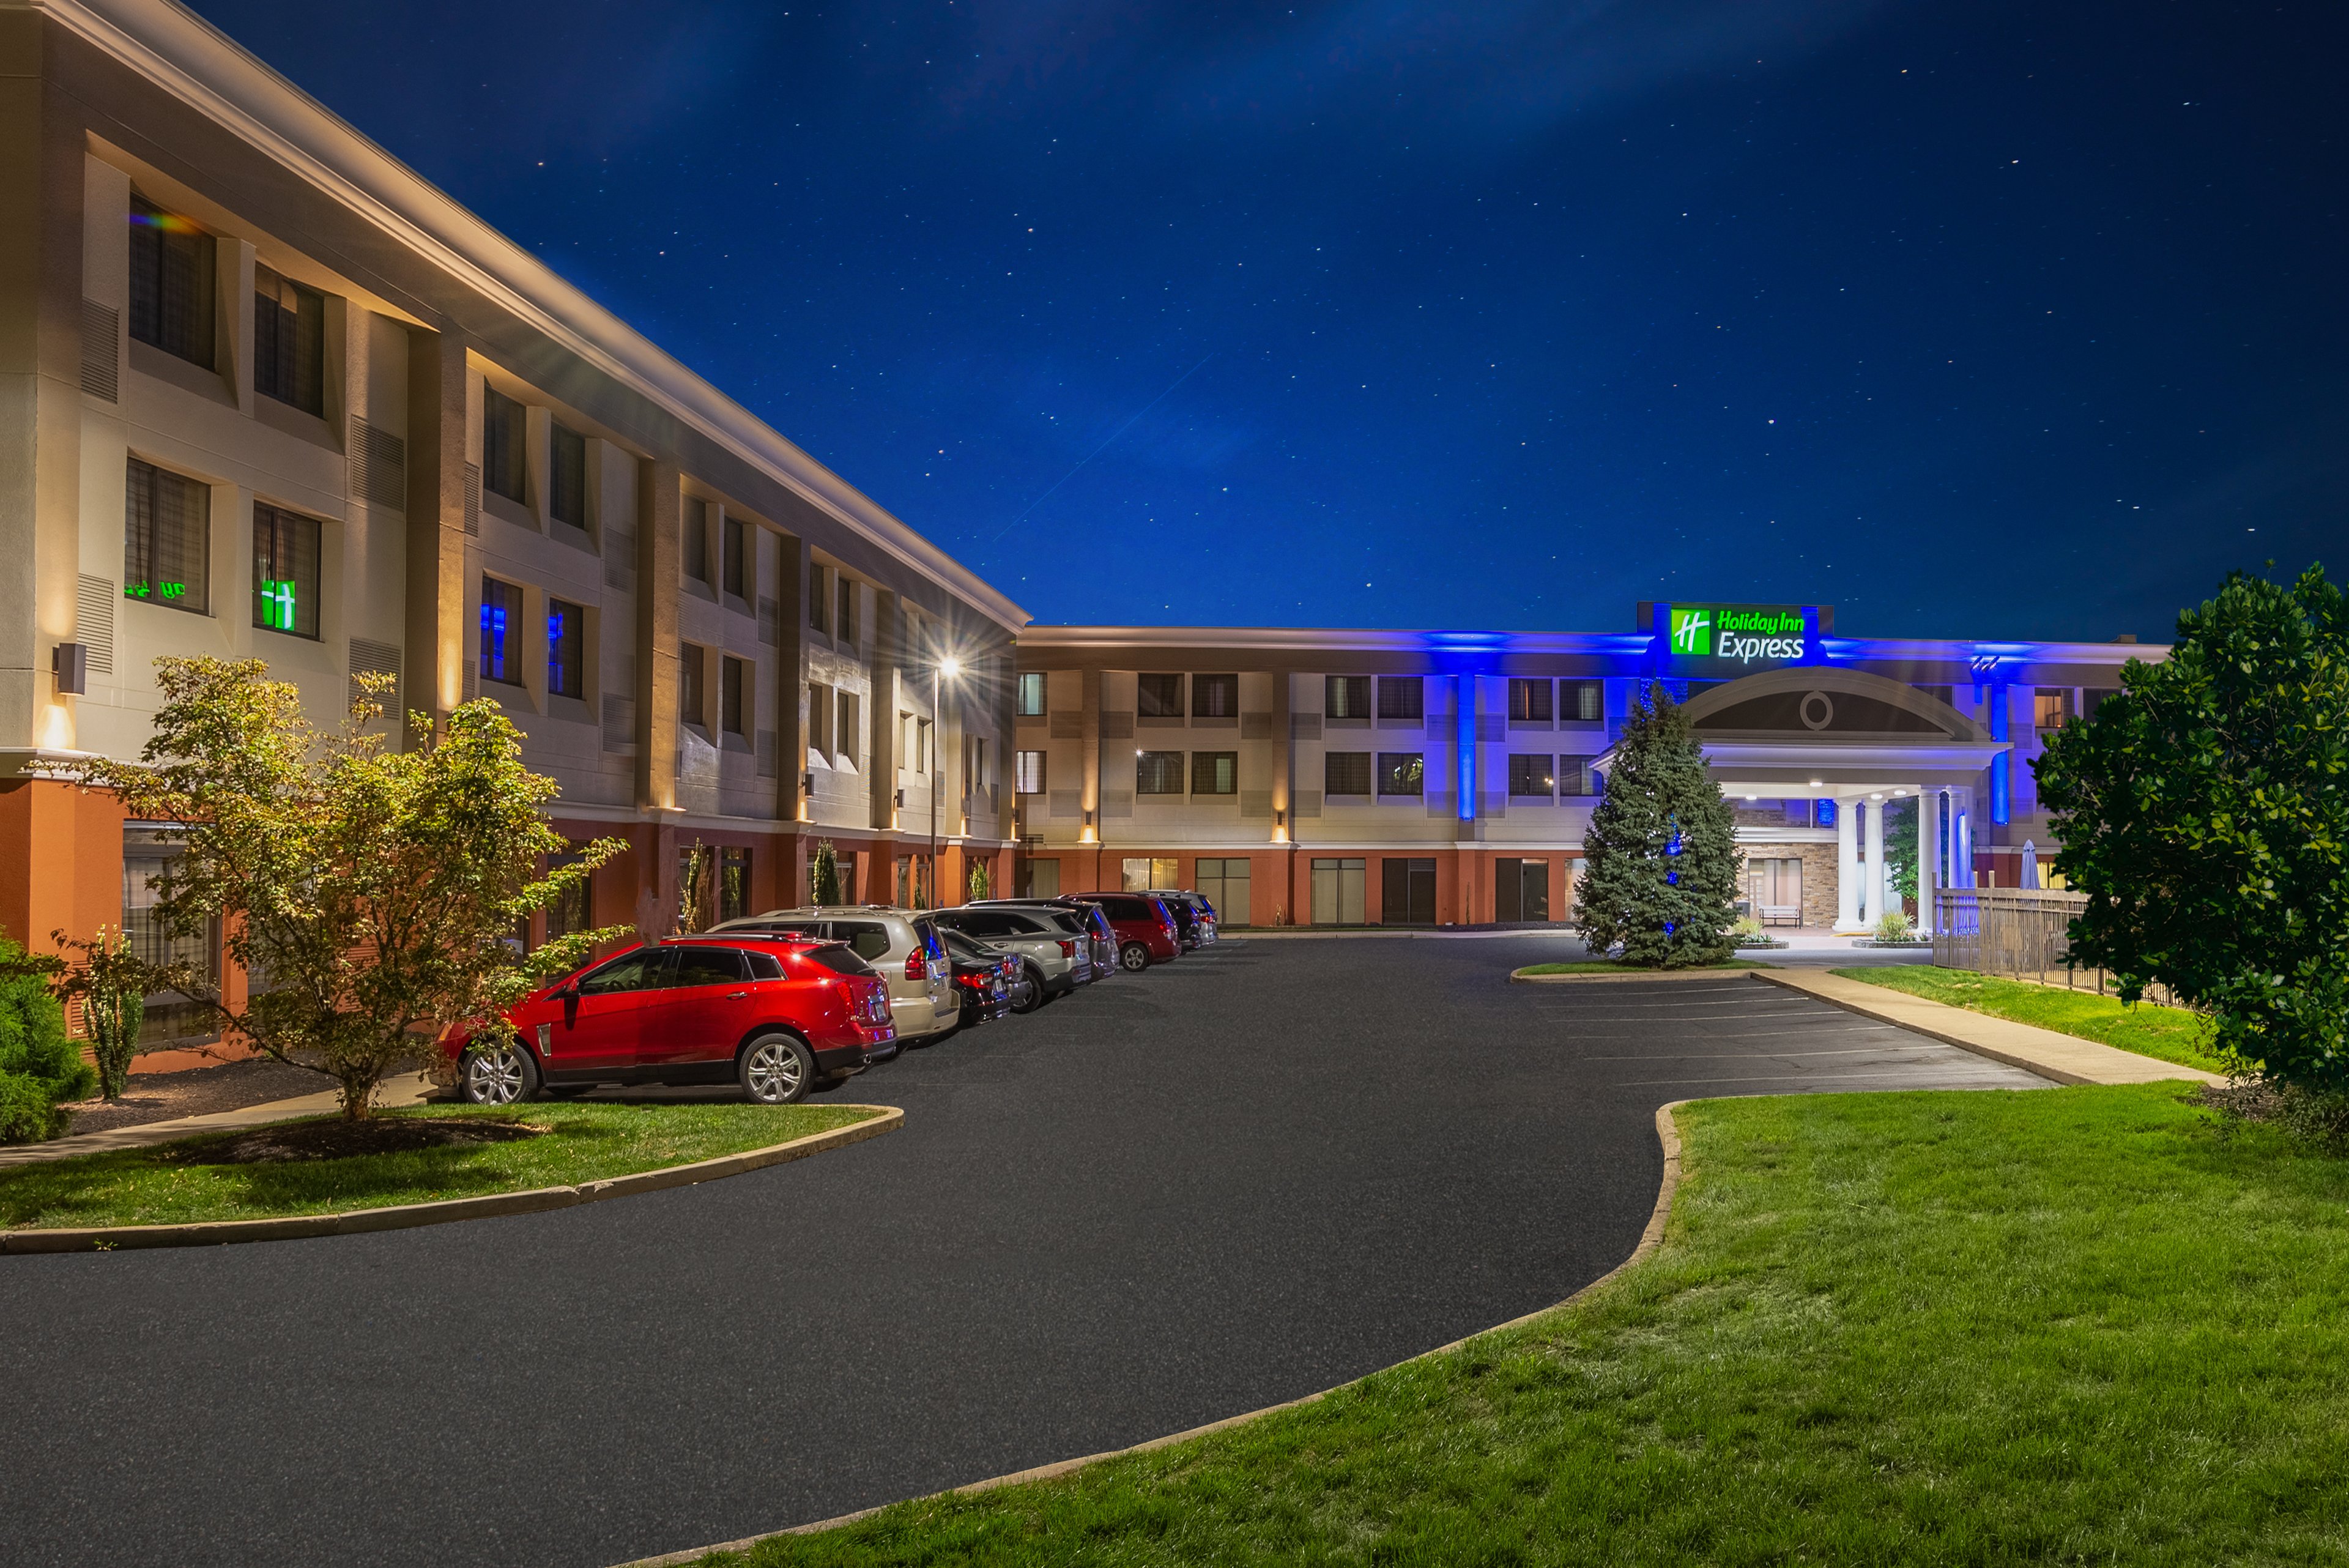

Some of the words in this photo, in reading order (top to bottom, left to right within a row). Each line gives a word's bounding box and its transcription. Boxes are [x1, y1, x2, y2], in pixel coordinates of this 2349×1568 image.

[1717, 610, 1778, 635] Holiday
[1779, 612, 1805, 631] Inn
[1718, 631, 1805, 664] Express
